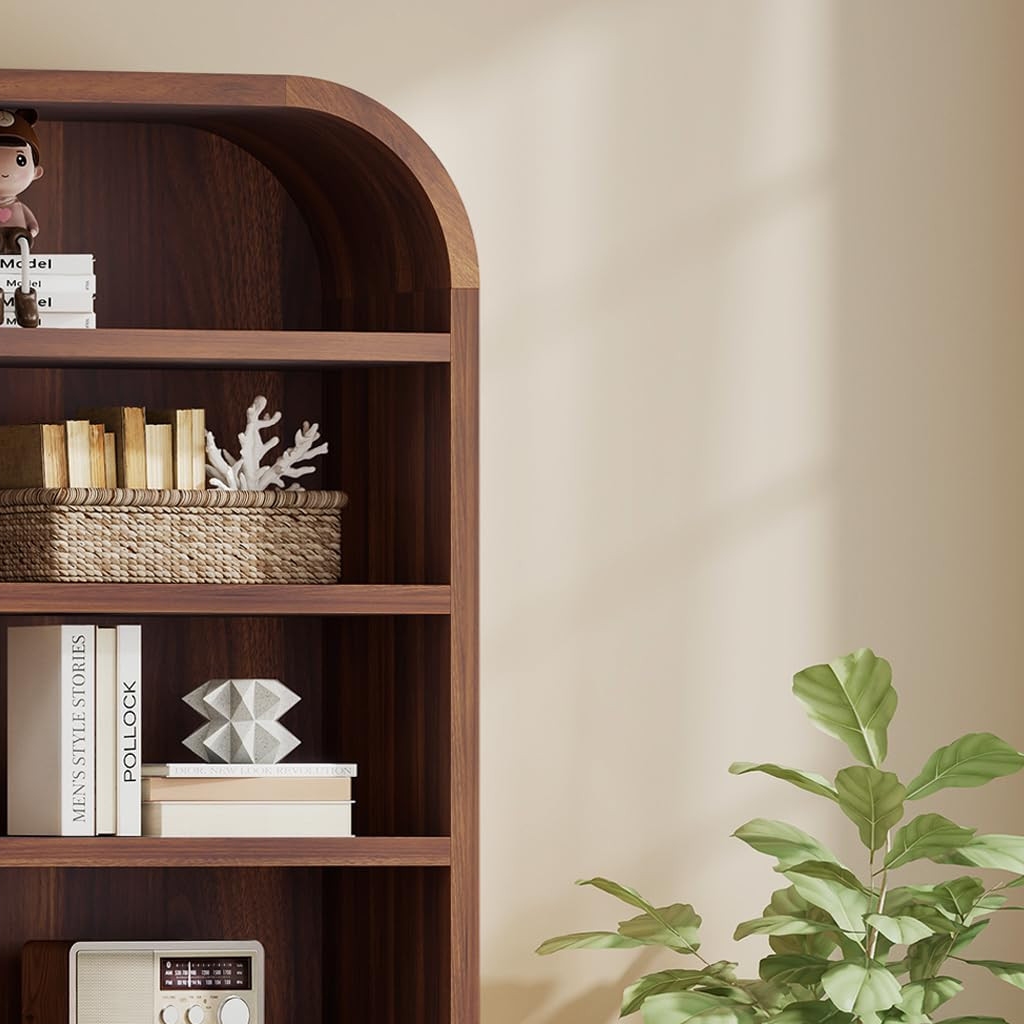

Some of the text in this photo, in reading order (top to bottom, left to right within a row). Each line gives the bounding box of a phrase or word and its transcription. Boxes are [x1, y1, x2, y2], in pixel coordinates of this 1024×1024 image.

[0, 258, 52, 269] Model
[6, 279, 41, 287] Moel
[3, 297, 52, 307] Mel
[72, 634, 86, 823] MEN'S STYLE STORIES
[123, 681, 137, 782] POLLOCK
